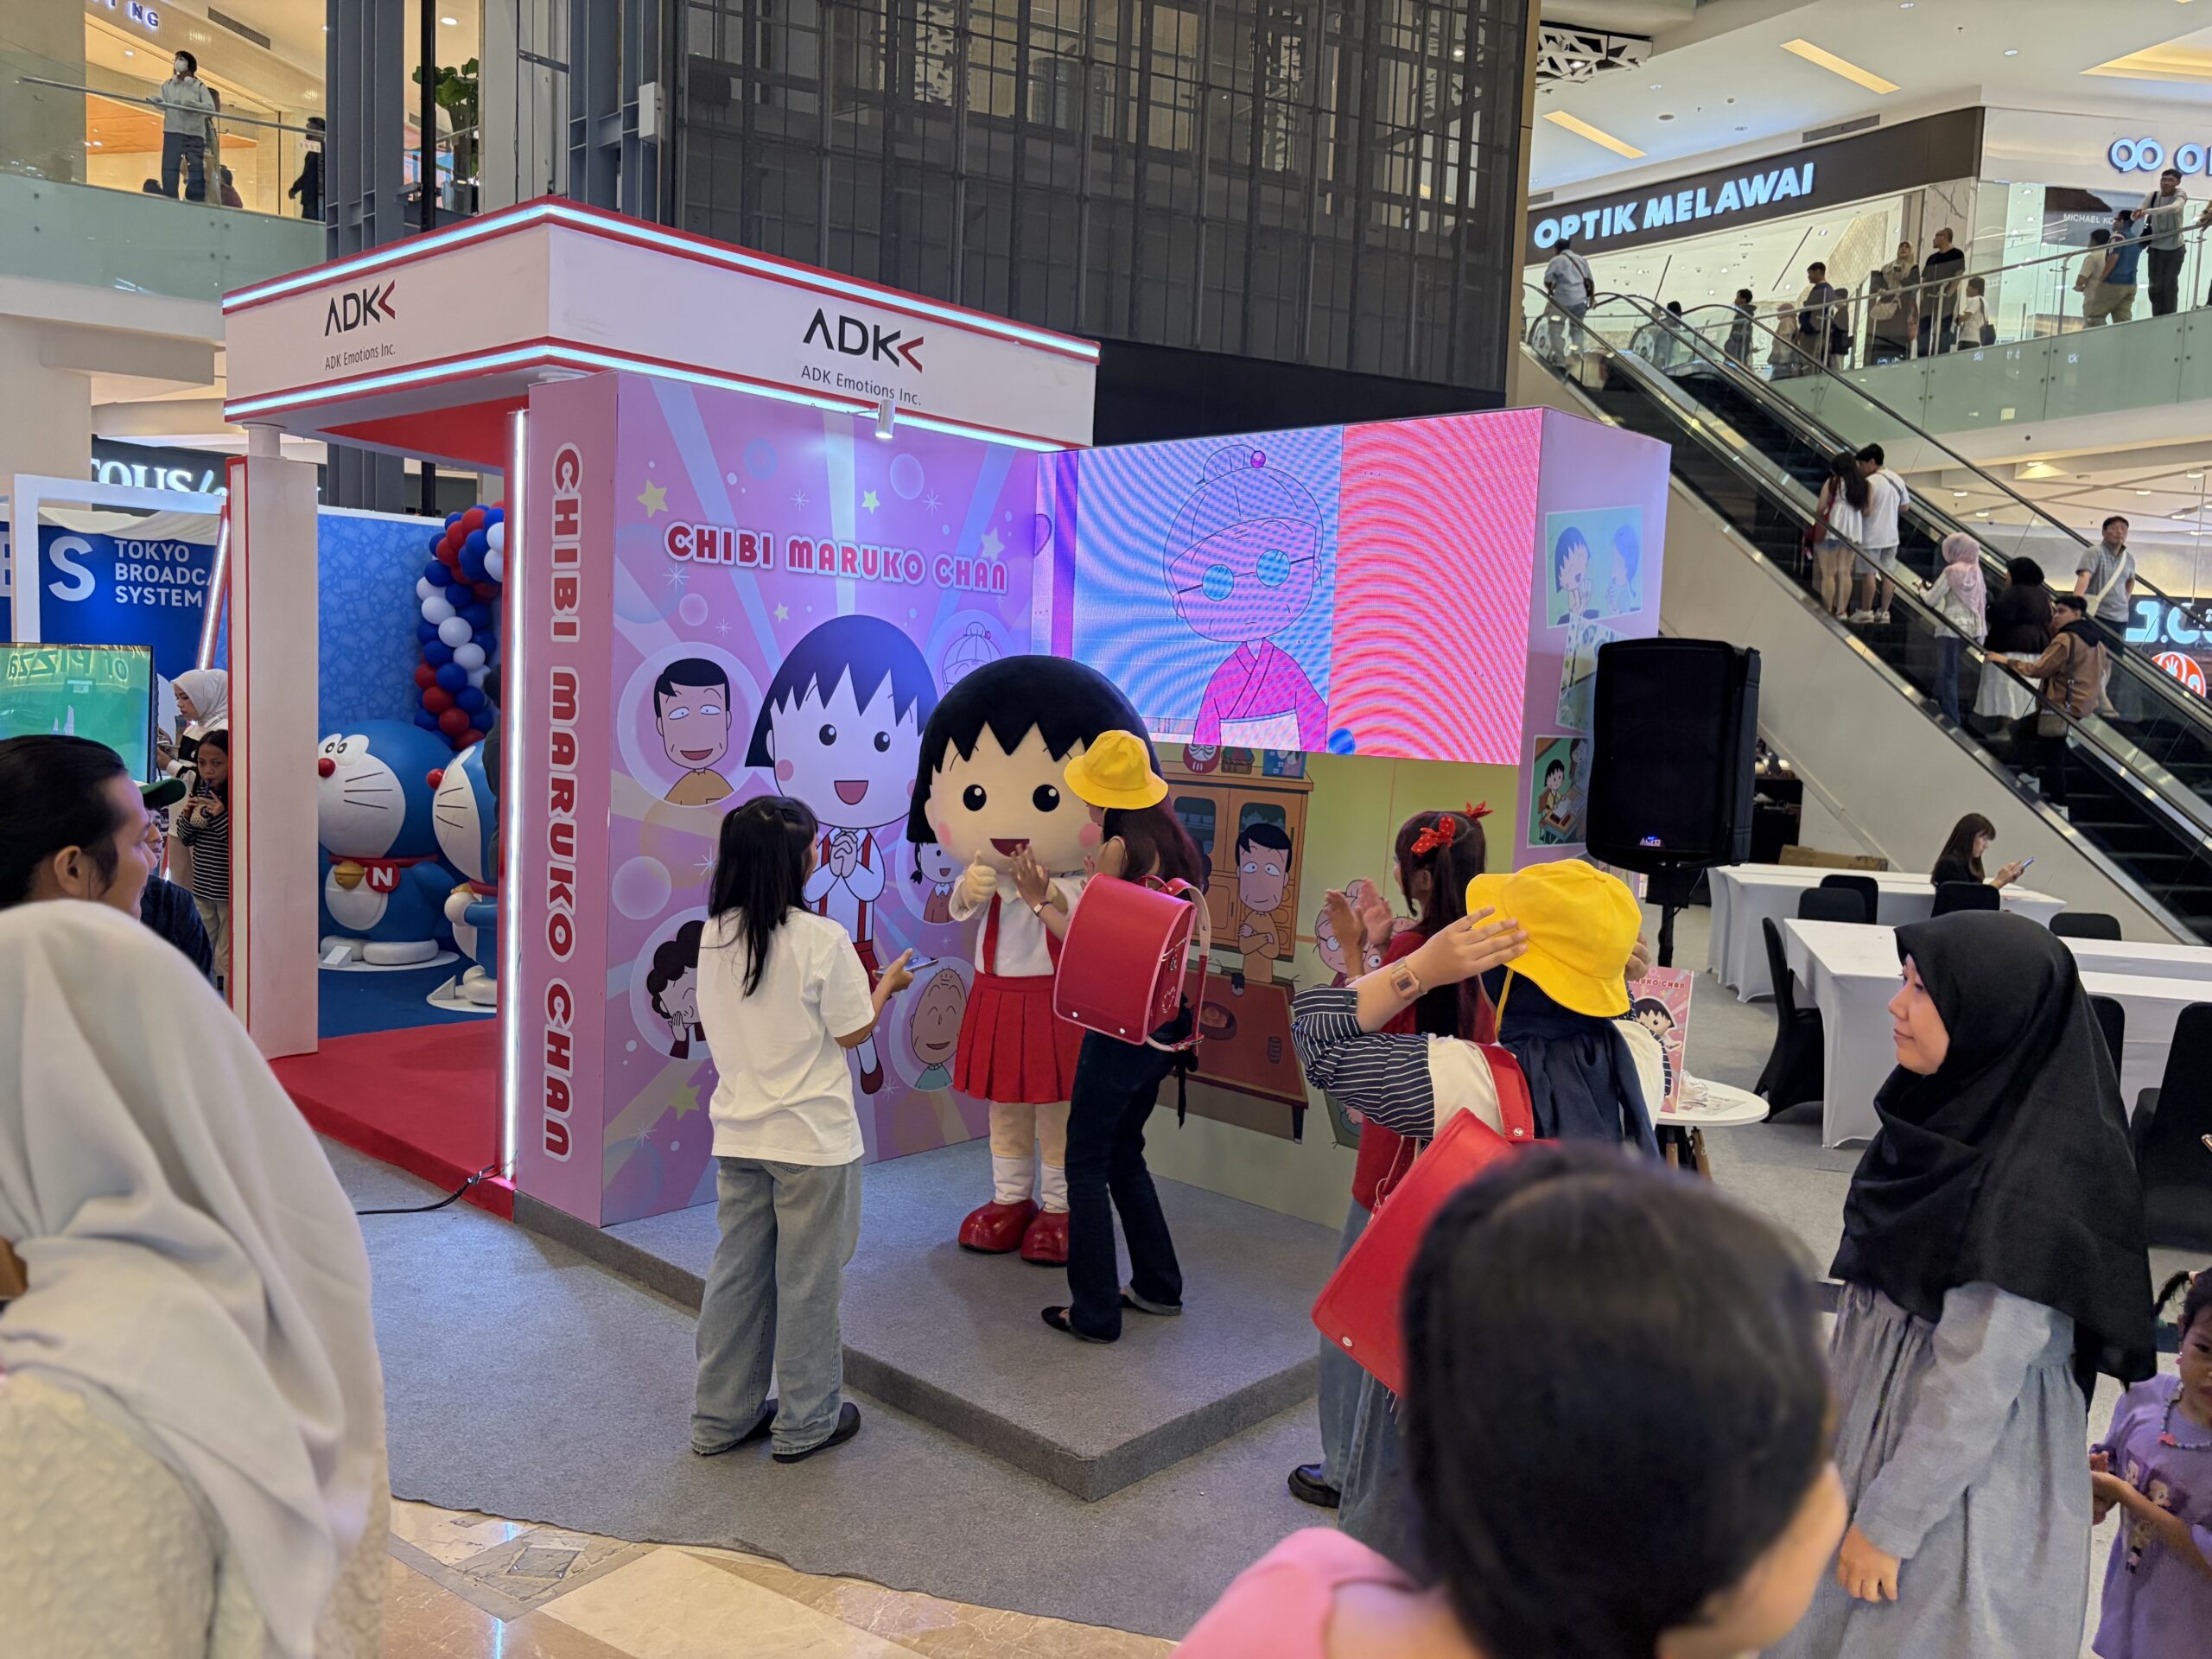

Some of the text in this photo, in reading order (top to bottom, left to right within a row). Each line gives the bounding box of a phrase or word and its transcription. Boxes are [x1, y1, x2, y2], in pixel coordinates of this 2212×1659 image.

[2174, 143, 2212, 176] O
[1534, 162, 1815, 249] OPTIK MELAWAI
[2063, 213, 2101, 224] MICHAEL
[325, 283, 381, 337] ADK
[803, 308, 901, 368] ADK
[325, 343, 396, 371] ADK Emotions Inc.
[801, 365, 922, 406] ADK Emotions Inc.
[91, 458, 193, 493] OUS
[114, 539, 189, 563] TOKYO
[664, 522, 1007, 594] CHIBI MARUKO CHAN
[115, 563, 213, 587] BROADC
[115, 585, 202, 607] SYSTEM
[2126, 601, 2212, 645] J.C
[543, 442, 583, 1162] CHIBI MARUKO CHAN
[372, 867, 393, 887] N
